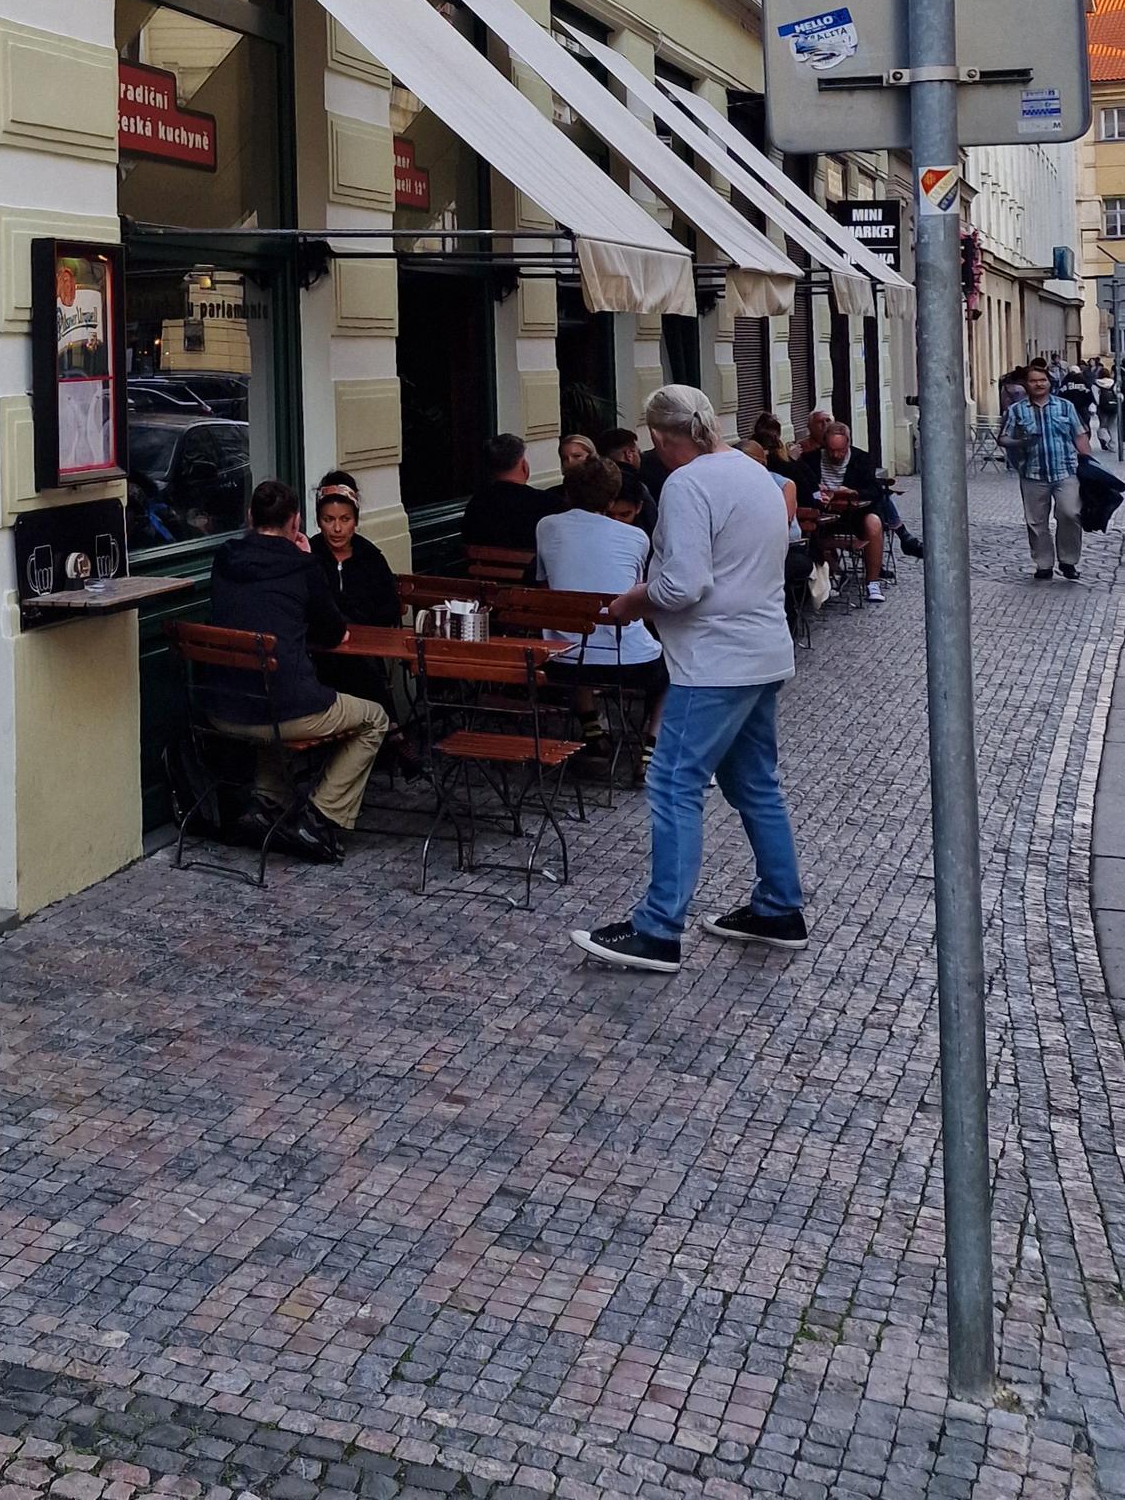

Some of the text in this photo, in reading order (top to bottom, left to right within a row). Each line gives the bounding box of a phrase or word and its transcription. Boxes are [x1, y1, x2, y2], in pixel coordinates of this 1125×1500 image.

[794, 15, 834, 33] HELLO
[158, 120, 209, 151] kuchyně
[852, 208, 883, 221] MINI
